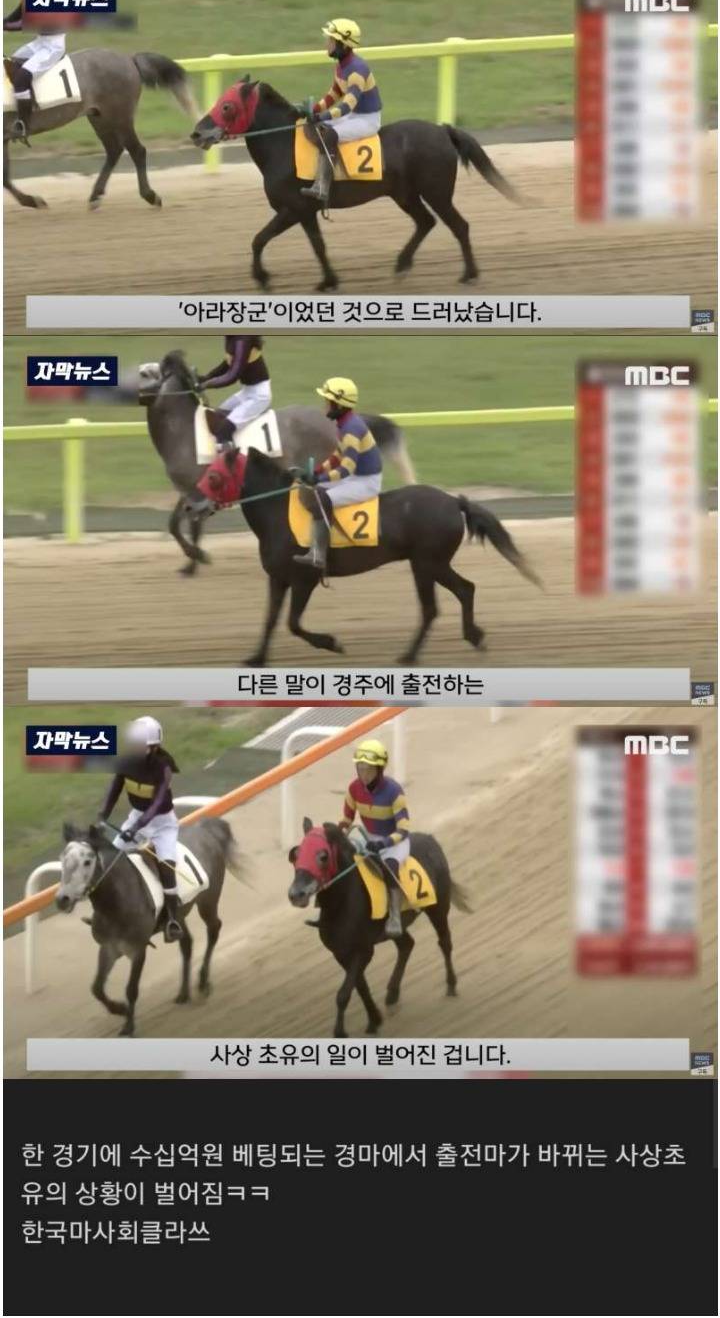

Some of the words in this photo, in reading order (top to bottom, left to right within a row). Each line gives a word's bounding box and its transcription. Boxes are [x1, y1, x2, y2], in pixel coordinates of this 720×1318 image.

[59, 69, 72, 98] 1
[357, 145, 374, 173] 2
[262, 423, 273, 452] 1
[352, 510, 370, 539] 2
[184, 854, 204, 885] 1
[409, 869, 429, 900] 2
